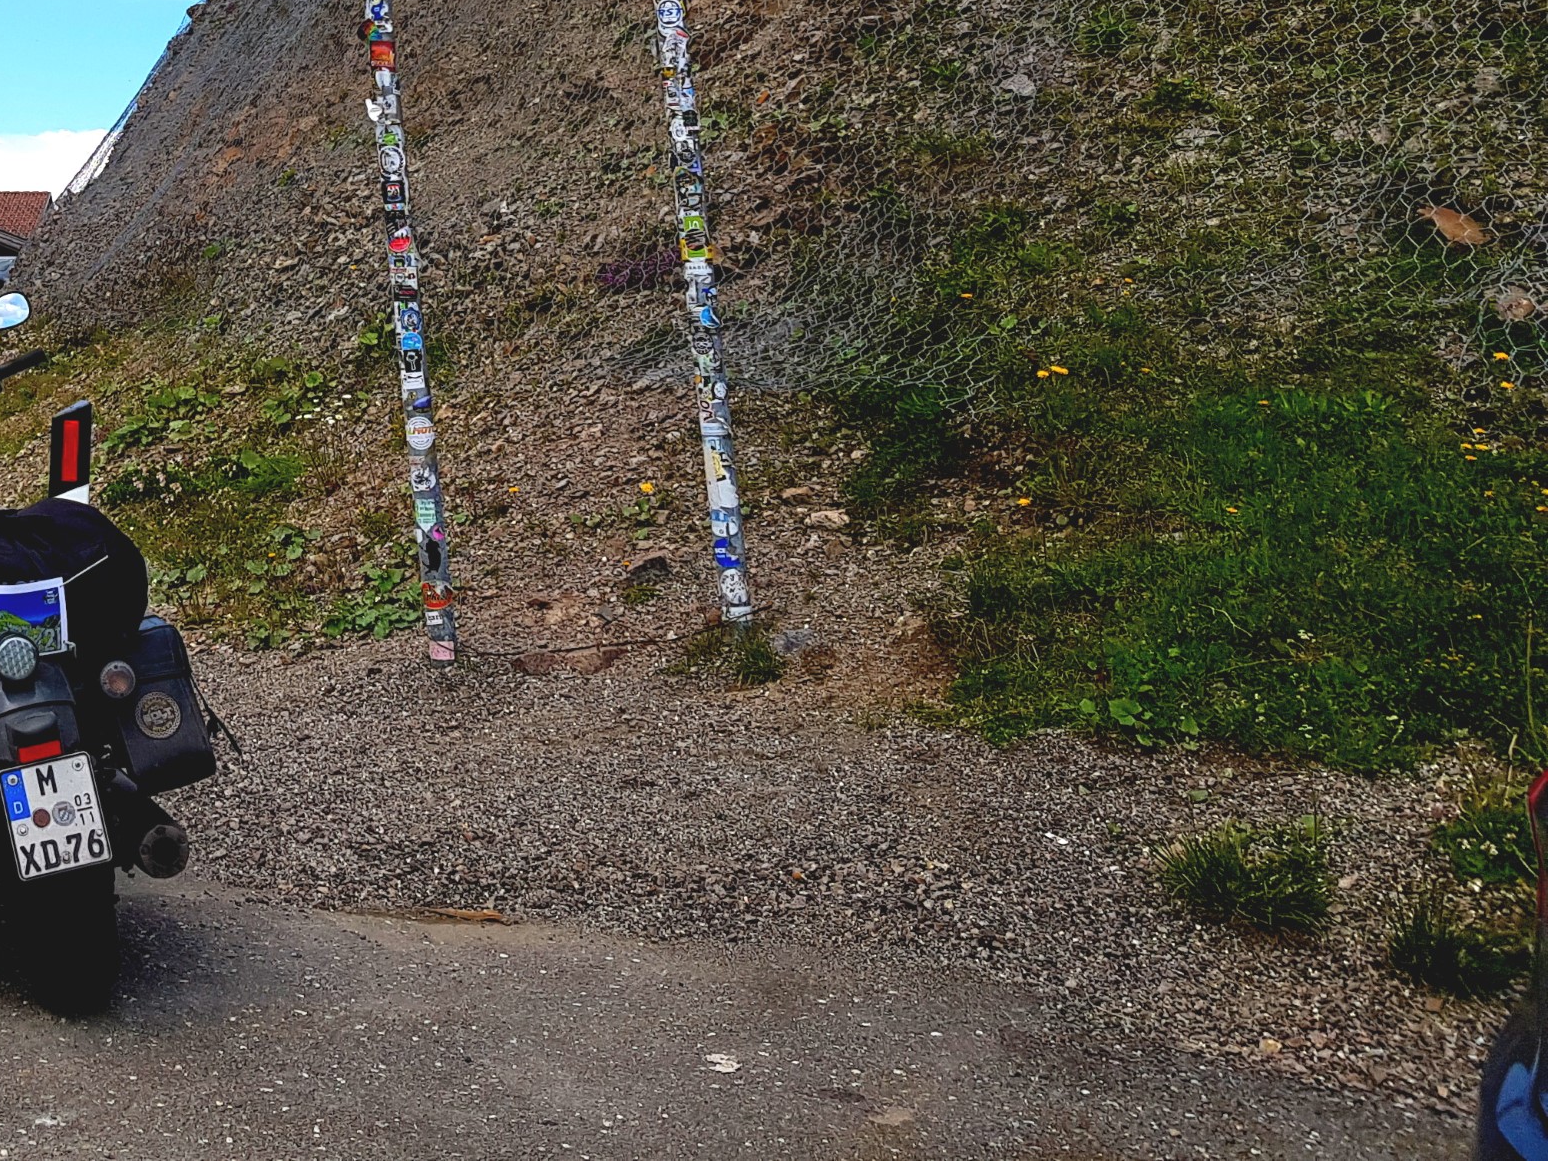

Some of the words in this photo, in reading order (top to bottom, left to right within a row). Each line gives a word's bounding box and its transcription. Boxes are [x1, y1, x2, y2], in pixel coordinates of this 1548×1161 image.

[35, 765, 58, 796] M
[74, 793, 91, 807] 03
[13, 801, 24, 814] D
